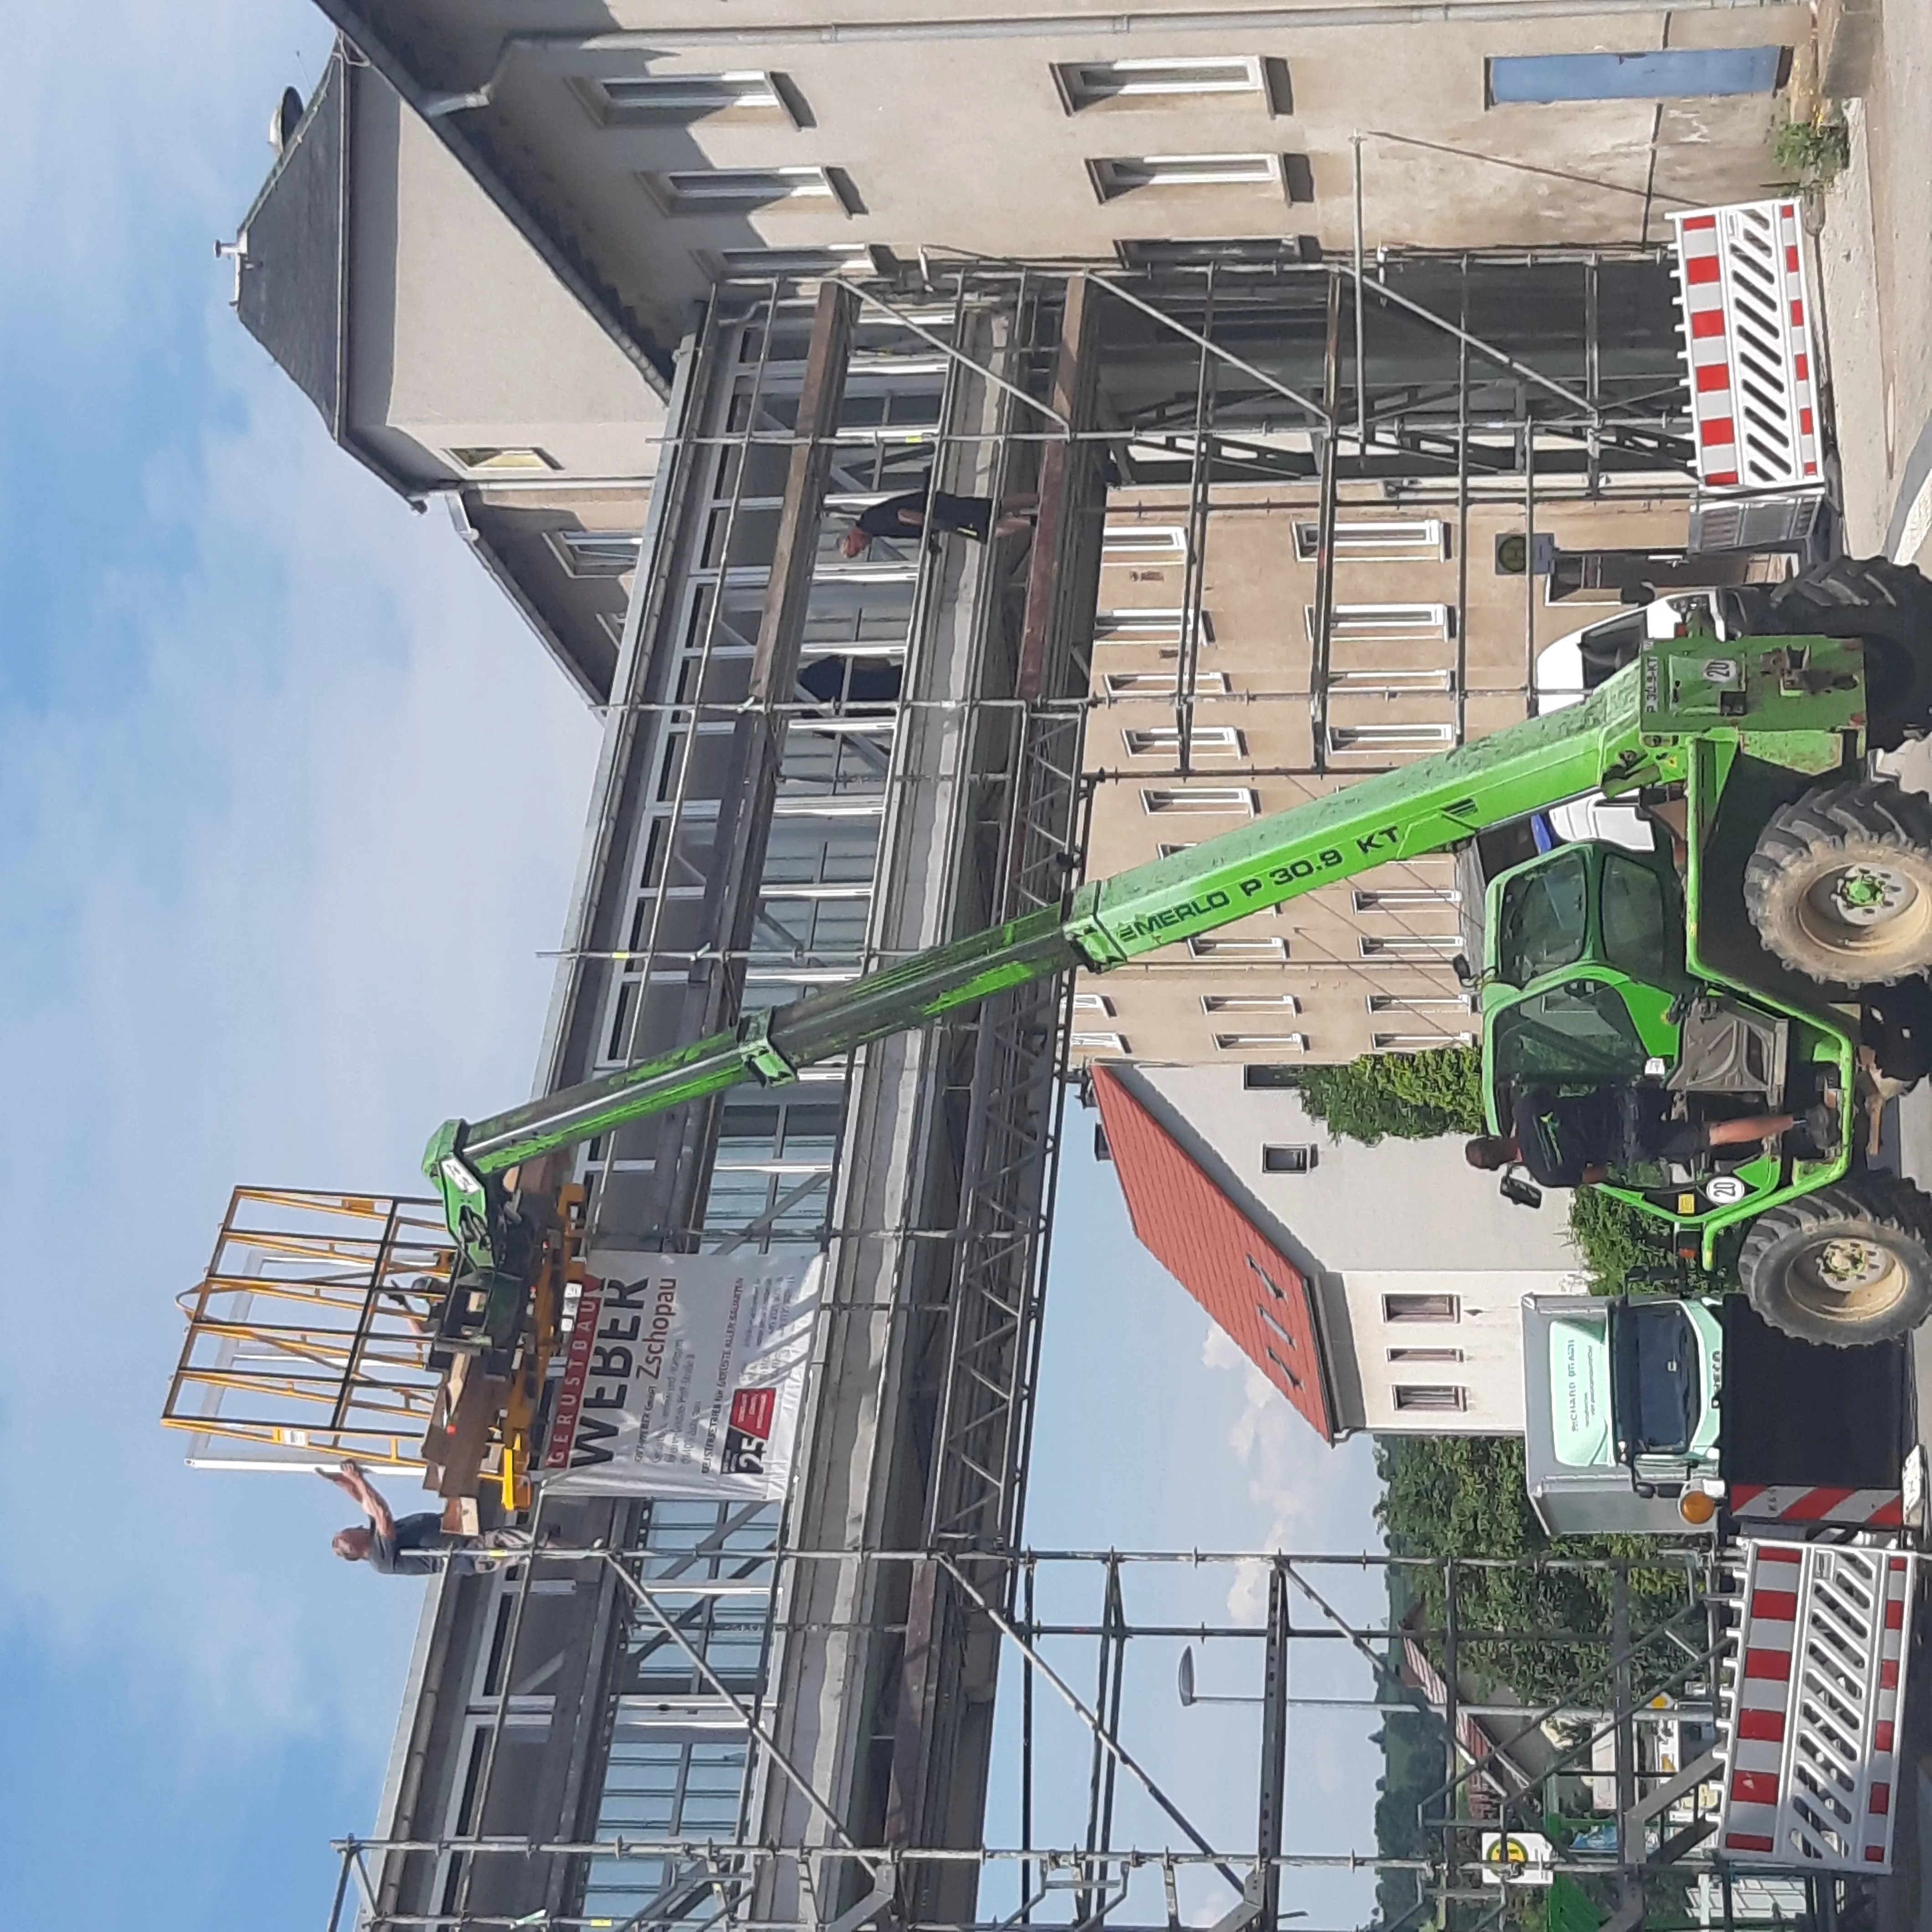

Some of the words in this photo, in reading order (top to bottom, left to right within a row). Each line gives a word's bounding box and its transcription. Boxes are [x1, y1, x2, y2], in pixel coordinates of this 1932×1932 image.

[1706, 662, 1730, 678] 20
[1133, 891, 1230, 935] MERLO
[1239, 878, 1263, 897] P
[1269, 848, 1343, 885] 30.9
[1356, 826, 1398, 854] KT
[1713, 1182, 1736, 1197] 20
[636, 1278, 676, 1380] Zschopau
[570, 1277, 649, 1468] WEBER
[739, 1438, 766, 1468] 25
